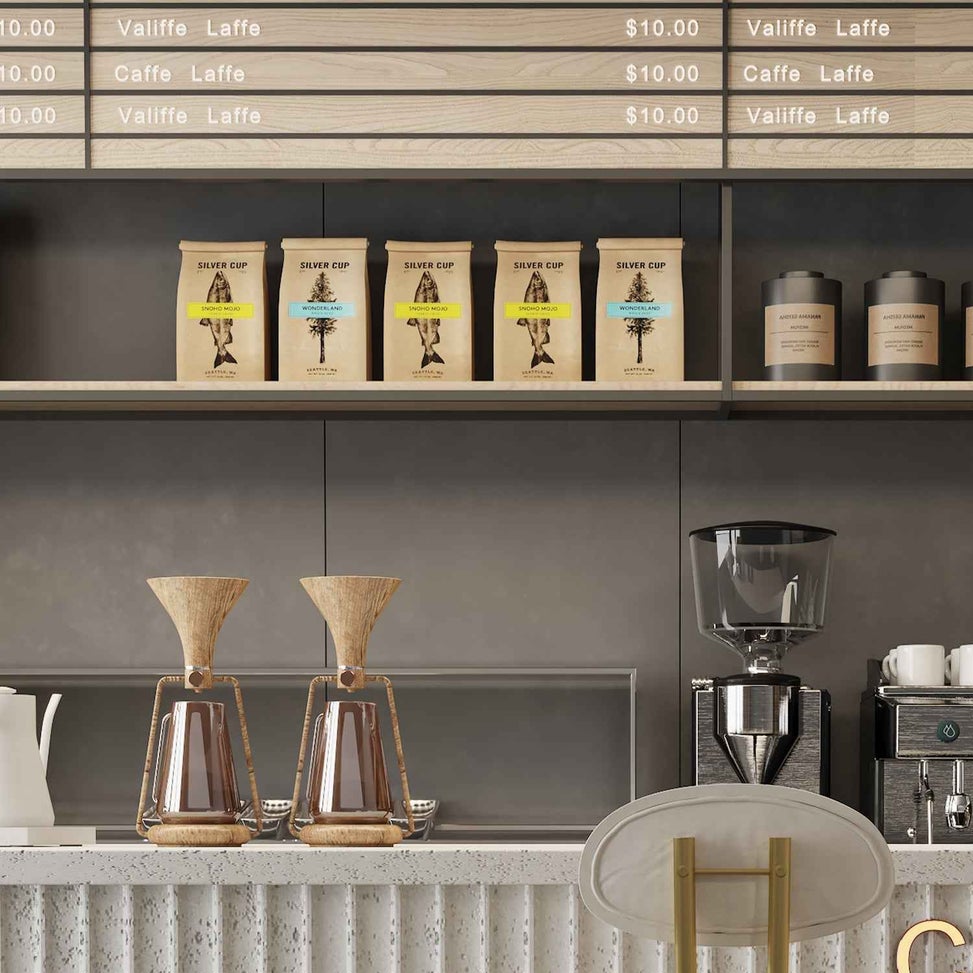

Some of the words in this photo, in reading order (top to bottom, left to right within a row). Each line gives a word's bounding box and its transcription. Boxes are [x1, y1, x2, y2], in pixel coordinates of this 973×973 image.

[118, 19, 187, 36] Valiffe
[207, 19, 261, 36] Laffe
[626, 18, 698, 38] $10.00
[746, 19, 816, 37] Valiffe
[837, 19, 890, 37] Laffe
[115, 65, 171, 82] Caffe
[192, 65, 245, 82] Laffe
[626, 64, 698, 84] $10.00
[743, 65, 800, 83] Caffe
[821, 65, 874, 83] Laffe
[119, 107, 187, 124] Valiffe
[208, 107, 261, 124] Laffe
[627, 106, 698, 126] $10.00
[747, 107, 816, 124] Valiffe
[836, 107, 889, 124] Laffe
[198, 261, 227, 269] SILVER
[230, 261, 248, 269] CUP
[300, 261, 329, 269] SILVER
[332, 261, 350, 269] CUP
[404, 261, 434, 269] SILVER
[436, 261, 455, 269] CUP
[514, 261, 543, 269] SILVER
[546, 261, 564, 269] CUP
[616, 261, 645, 269] SILVER
[648, 261, 666, 269] CUP
